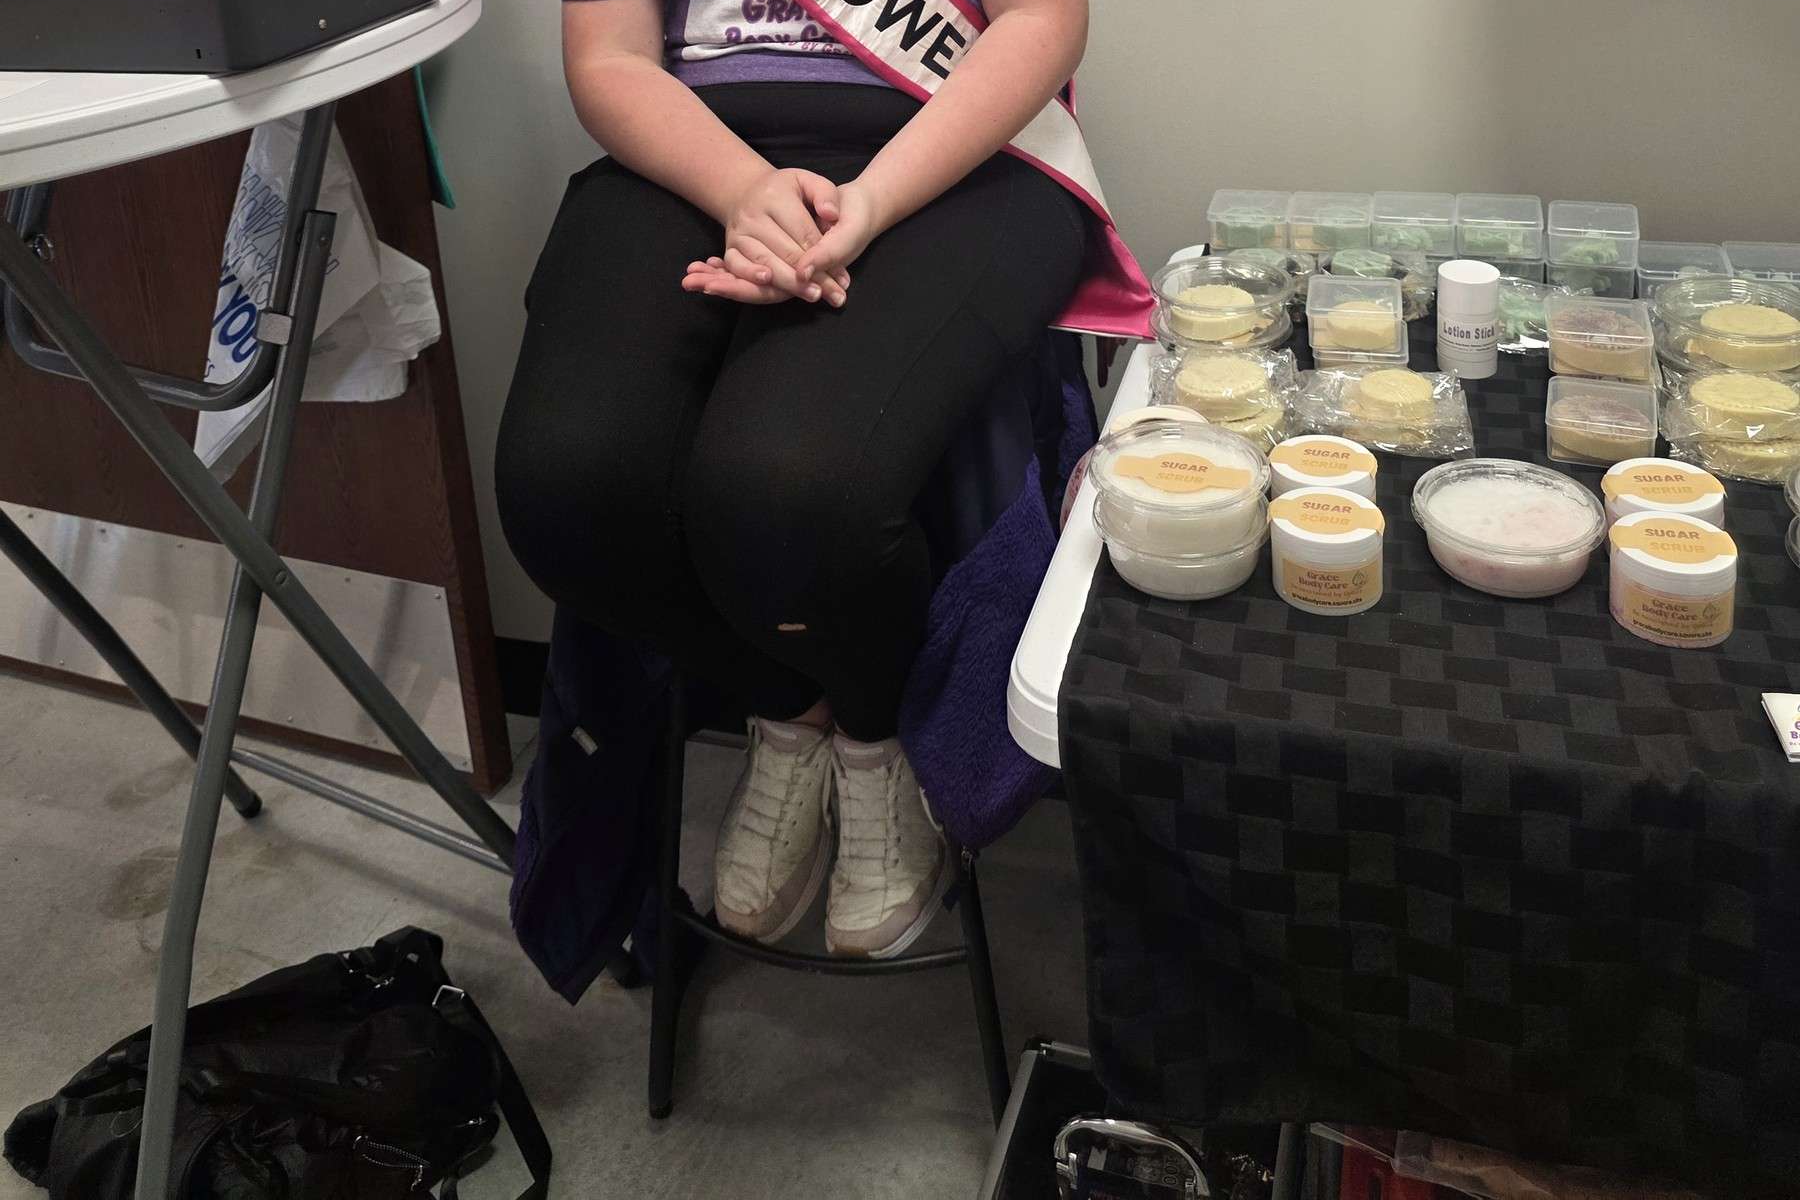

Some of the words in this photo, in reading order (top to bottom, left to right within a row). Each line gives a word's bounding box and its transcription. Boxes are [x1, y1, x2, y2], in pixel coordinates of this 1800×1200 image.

[1443, 322, 1471, 339] Lotion
[1302, 448, 1351, 460] SUGAR
[1160, 461, 1209, 473] SUGAR
[1633, 473, 1687, 483] SUGAR
[1301, 501, 1353, 514] SUGAR
[1643, 528, 1701, 540] SUGAR
